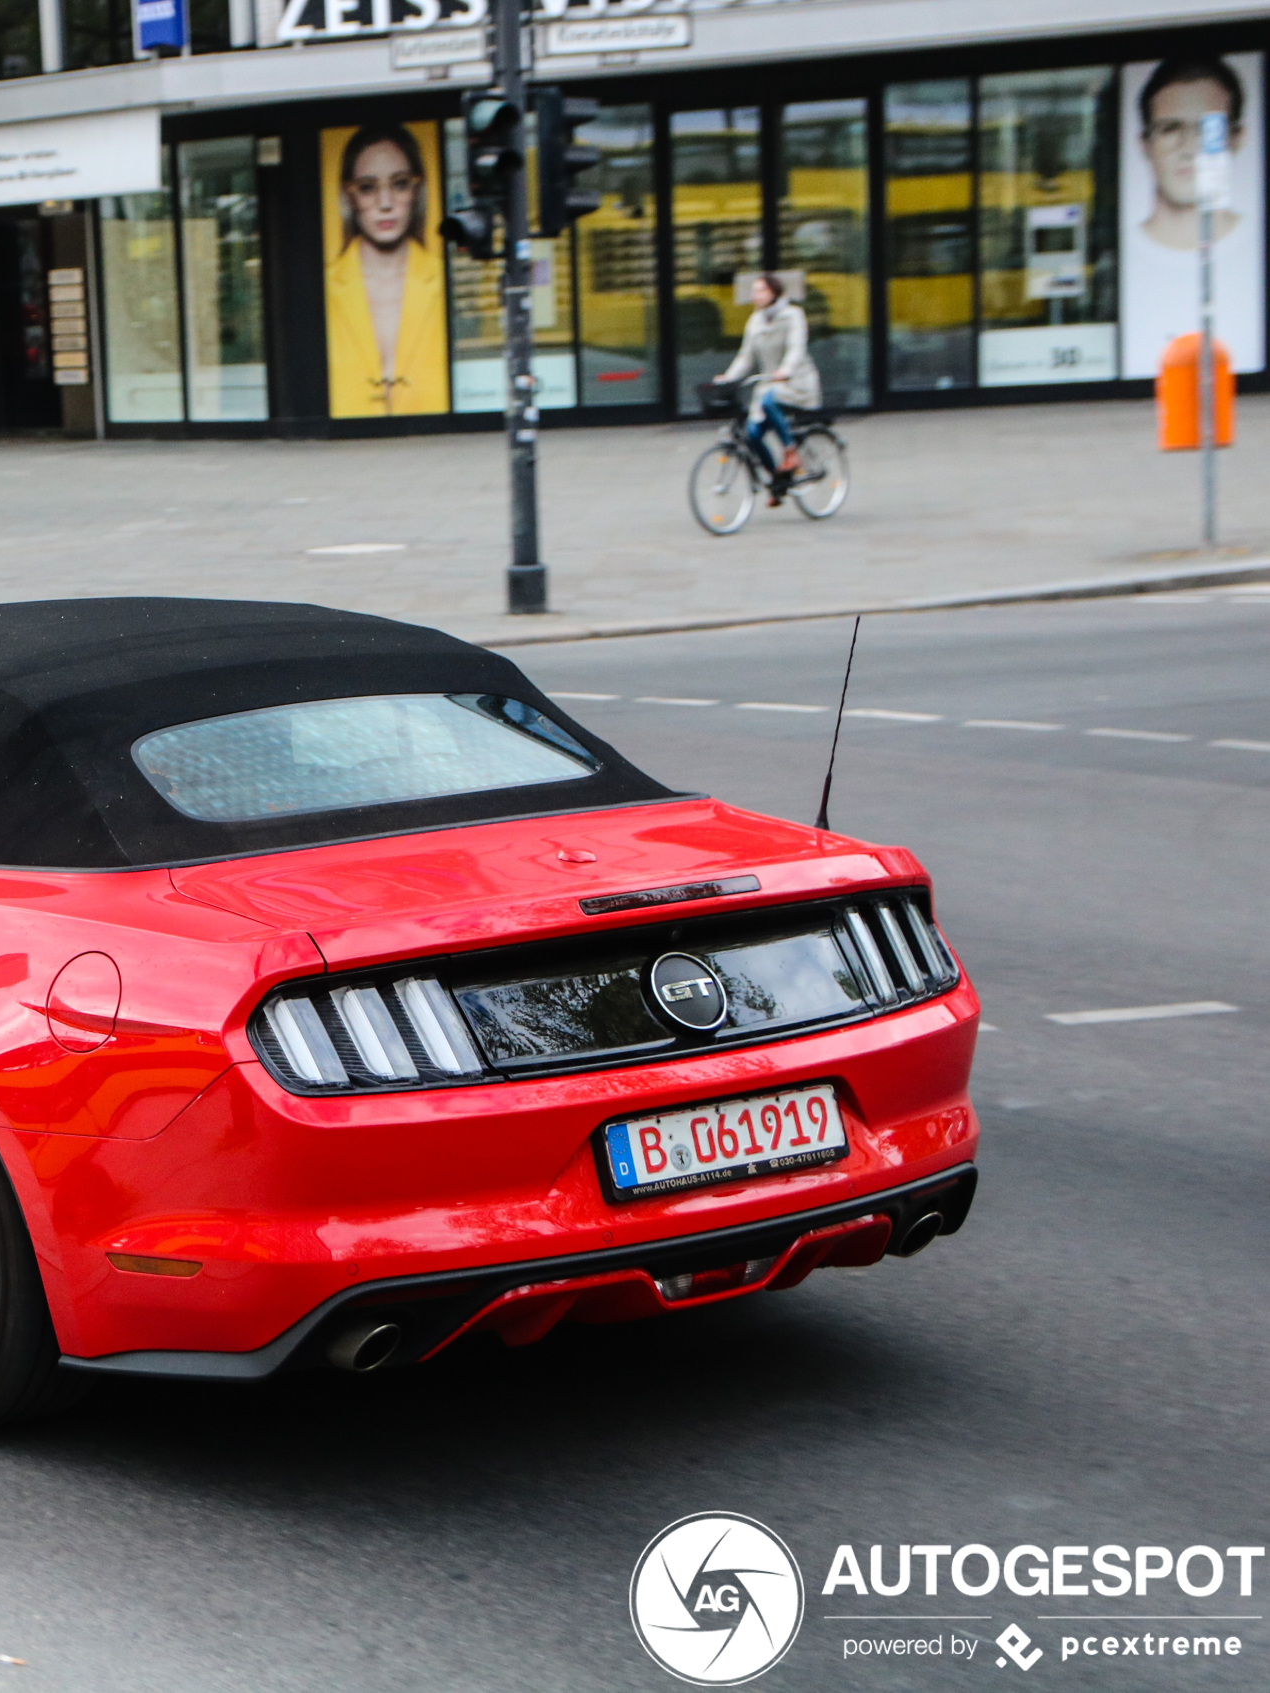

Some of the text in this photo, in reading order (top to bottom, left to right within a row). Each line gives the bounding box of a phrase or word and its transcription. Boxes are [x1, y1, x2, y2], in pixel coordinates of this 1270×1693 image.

[661, 977, 713, 1002] GT
[638, 1096, 828, 1175] B 061919
[619, 1161, 629, 1176] D
[631, 1168, 733, 1195] www.AUTOHAUS-A114.de
